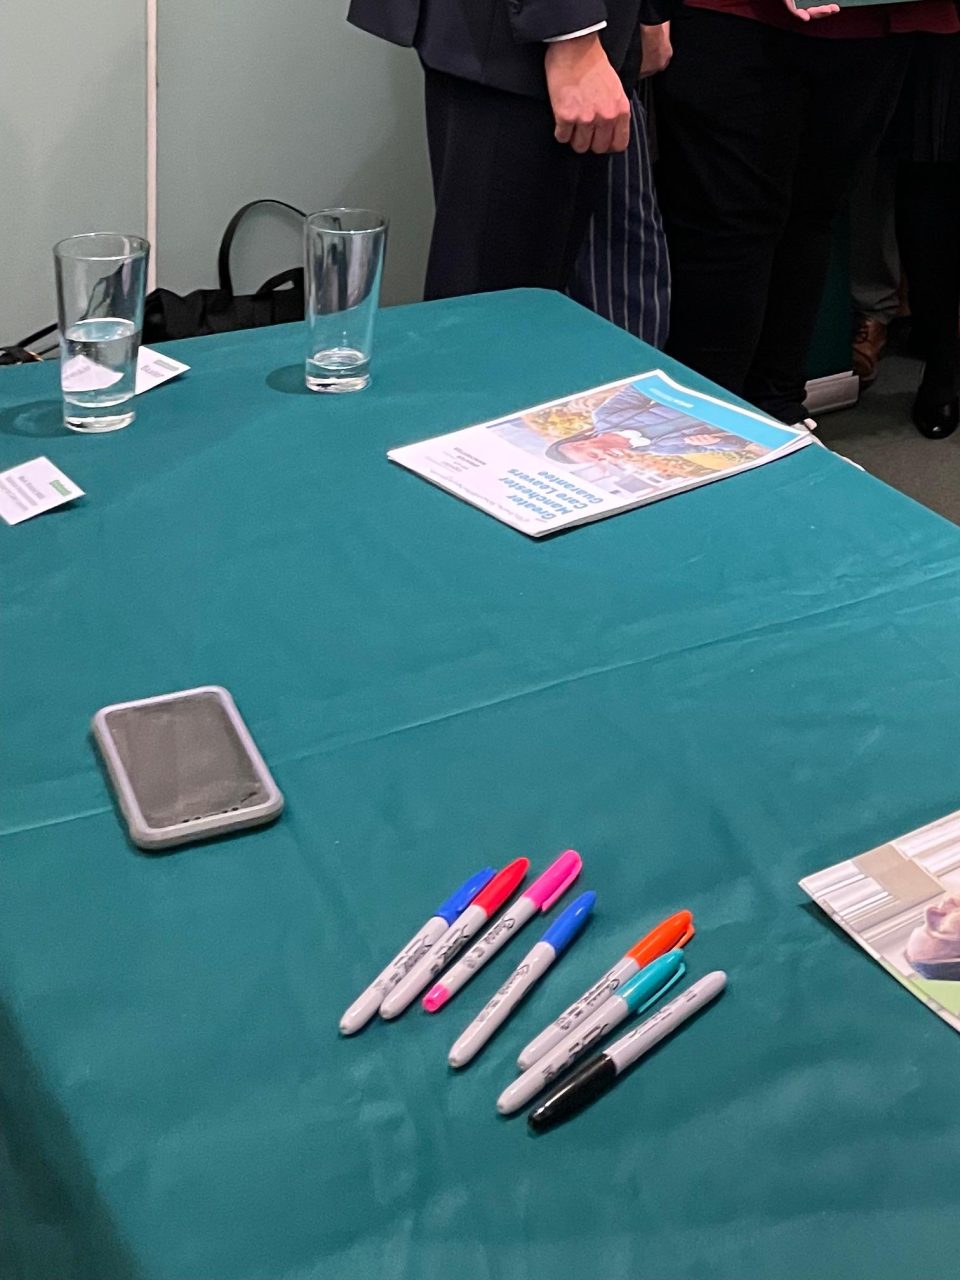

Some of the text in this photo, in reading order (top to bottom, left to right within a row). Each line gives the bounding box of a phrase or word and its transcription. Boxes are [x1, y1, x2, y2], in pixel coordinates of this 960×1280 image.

[498, 477, 574, 515] Manchester
[507, 468, 589, 509] Care Leavers
[537, 470, 604, 504] Guarantee
[506, 494, 557, 520] Greater
